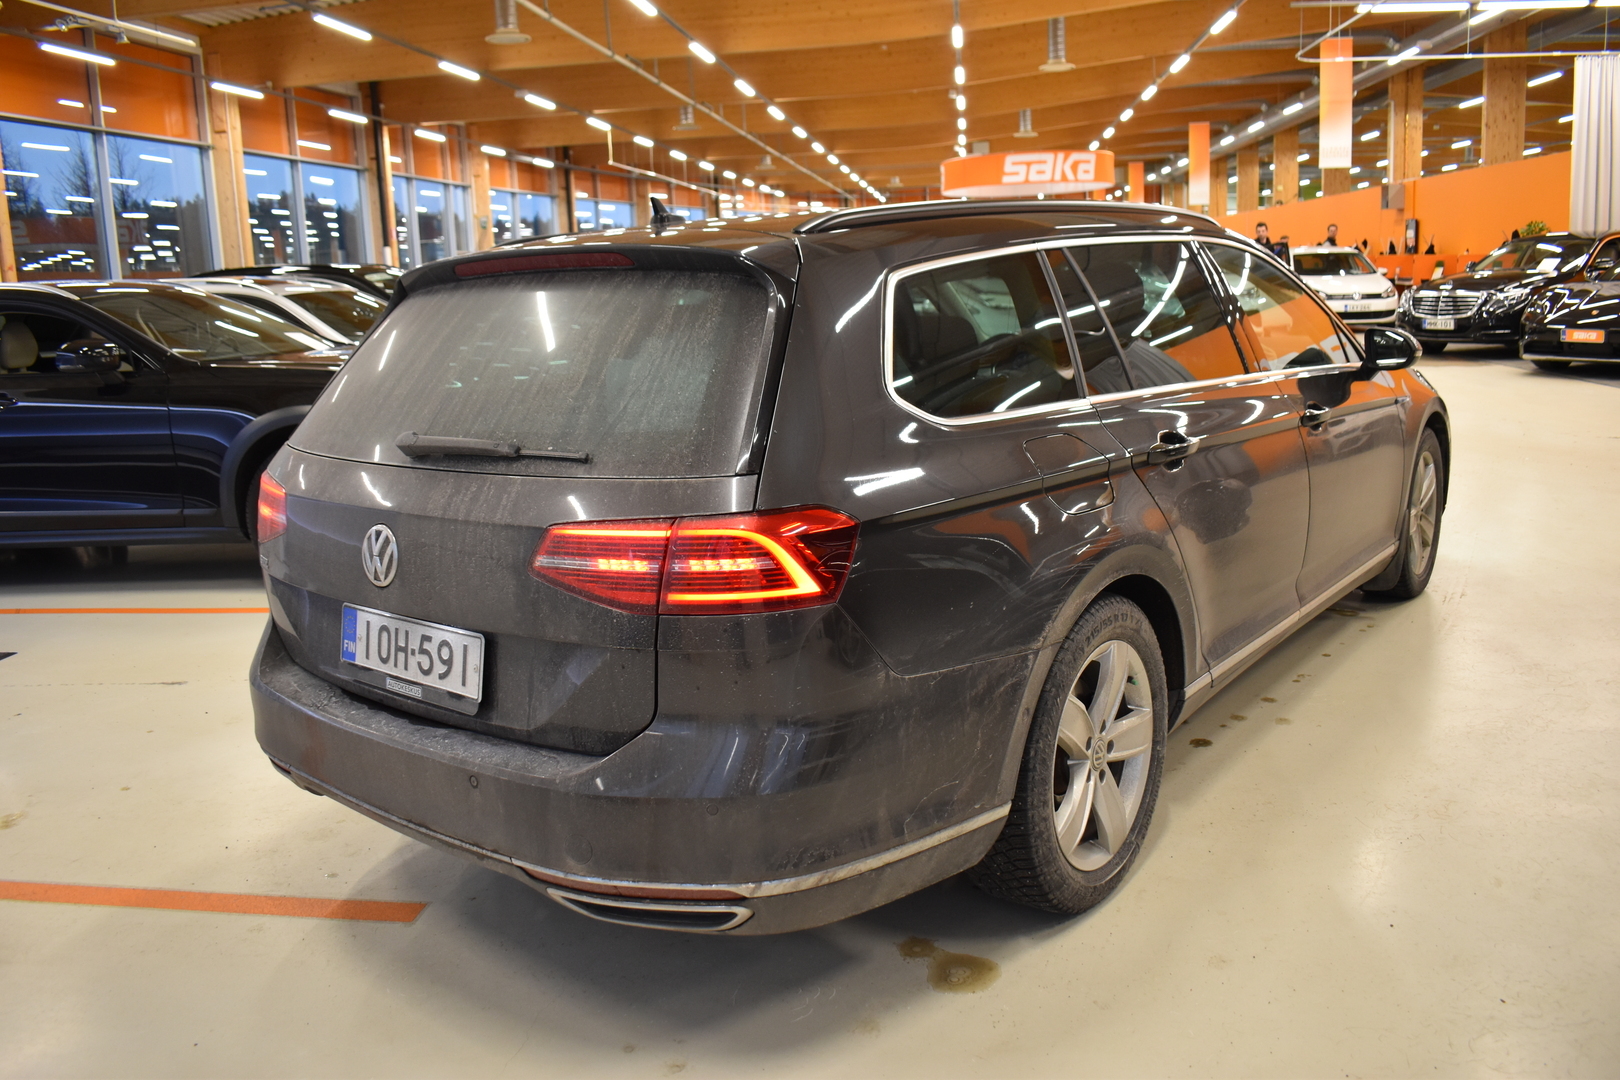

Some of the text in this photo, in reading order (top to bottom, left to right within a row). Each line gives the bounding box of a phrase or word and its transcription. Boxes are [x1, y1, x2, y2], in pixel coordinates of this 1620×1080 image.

[344, 639, 355, 654] FIN
[365, 620, 468, 687] IOH-591
[387, 680, 421, 696] AUTOKESKUS
